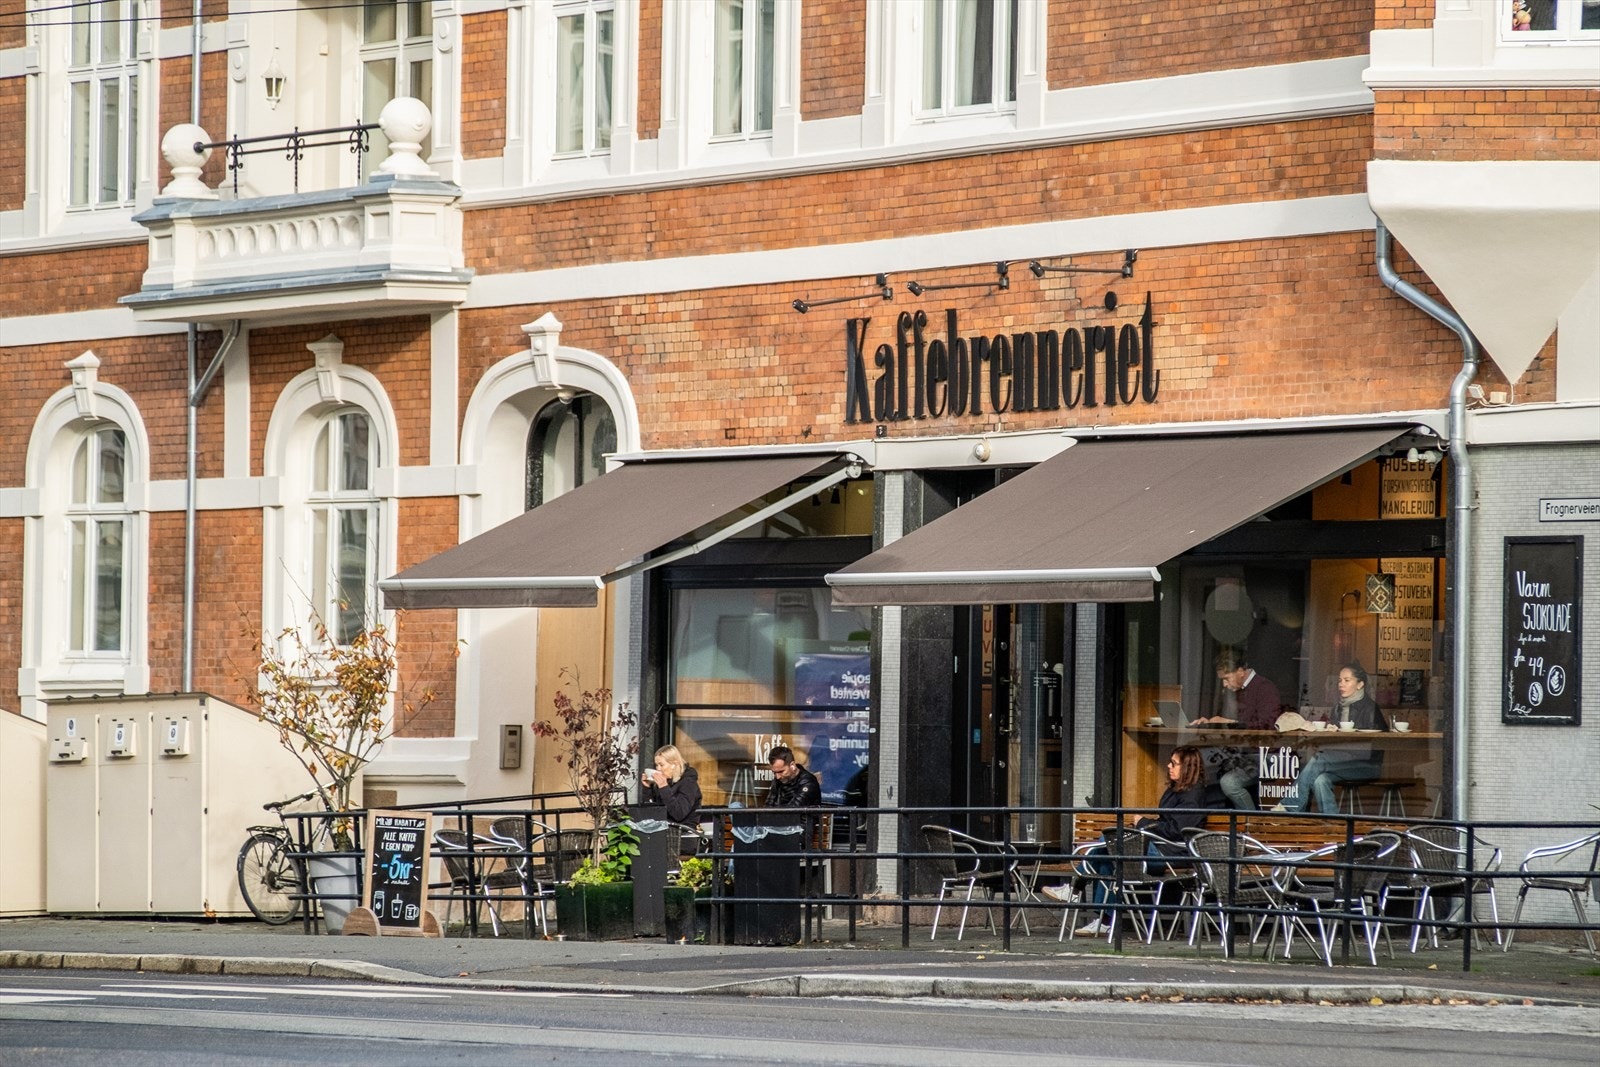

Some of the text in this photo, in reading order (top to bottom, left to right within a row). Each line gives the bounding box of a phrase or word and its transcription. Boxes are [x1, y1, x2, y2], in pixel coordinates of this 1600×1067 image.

[844, 291, 1160, 424] Kaffebrenneriet
[1382, 500, 1434, 515] MANGLERUD
[1545, 502, 1600, 517] Frognerveien
[1516, 571, 1551, 597] Varm
[1399, 606, 1433, 620] LANGERUD
[1523, 602, 1572, 632] SJOKOLADE
[1259, 746, 1300, 780] Kaffe
[1259, 780, 1299, 798] brenneriet
[383, 831, 417, 843] ALLE KAFFER
[385, 842, 401, 852] EGEN
[401, 843, 415, 852] KOPP
